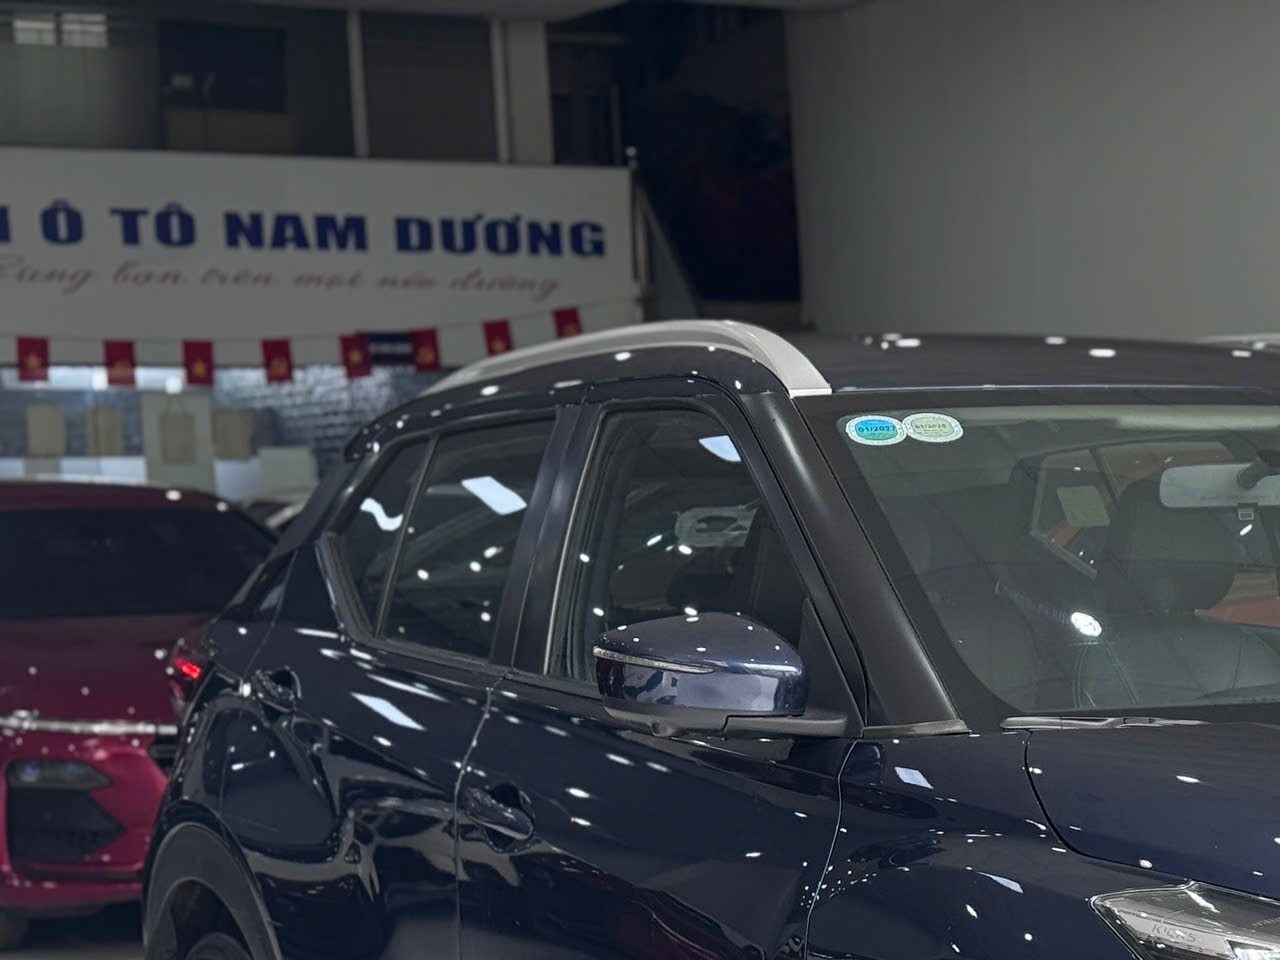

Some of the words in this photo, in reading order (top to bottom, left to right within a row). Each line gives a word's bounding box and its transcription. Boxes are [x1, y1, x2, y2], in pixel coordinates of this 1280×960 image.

[41, 199, 84, 246] Ô
[109, 202, 197, 247] TÔ
[224, 210, 369, 253] NAM
[395, 213, 606, 257] DƯƠNG
